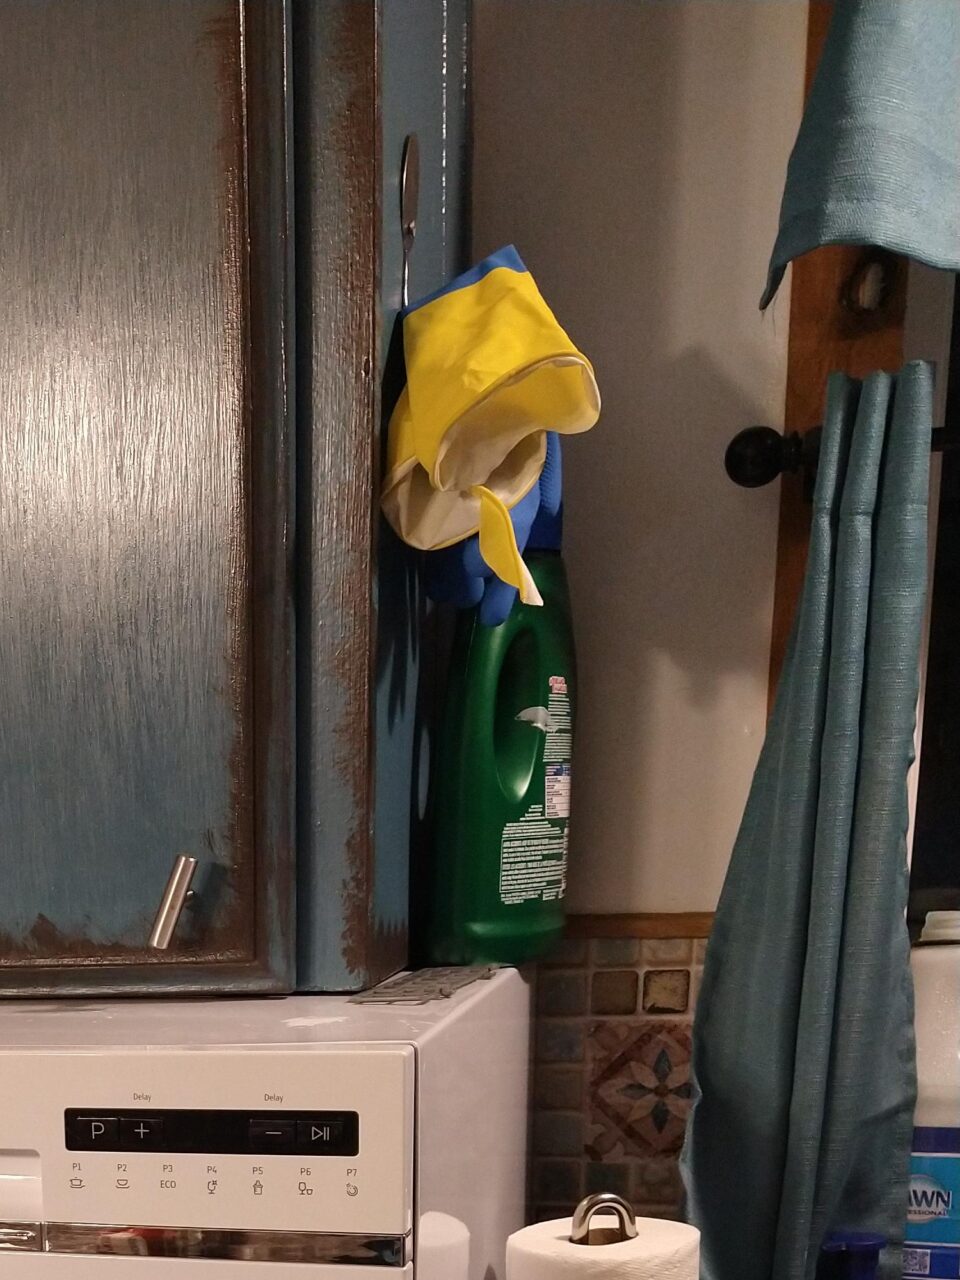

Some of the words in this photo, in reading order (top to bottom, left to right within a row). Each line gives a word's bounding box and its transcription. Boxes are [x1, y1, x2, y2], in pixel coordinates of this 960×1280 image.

[133, 1093, 152, 1103] Delay
[264, 1093, 283, 1103] Delay
[91, 1122, 105, 1139] P
[72, 1163, 82, 1172] P1
[117, 1163, 127, 1172] P2
[162, 1164, 173, 1173] P3
[207, 1165, 218, 1174] P4
[252, 1166, 264, 1175] P5
[300, 1167, 311, 1176] P6
[346, 1168, 357, 1177] P7
[160, 1180, 177, 1189] ECO
